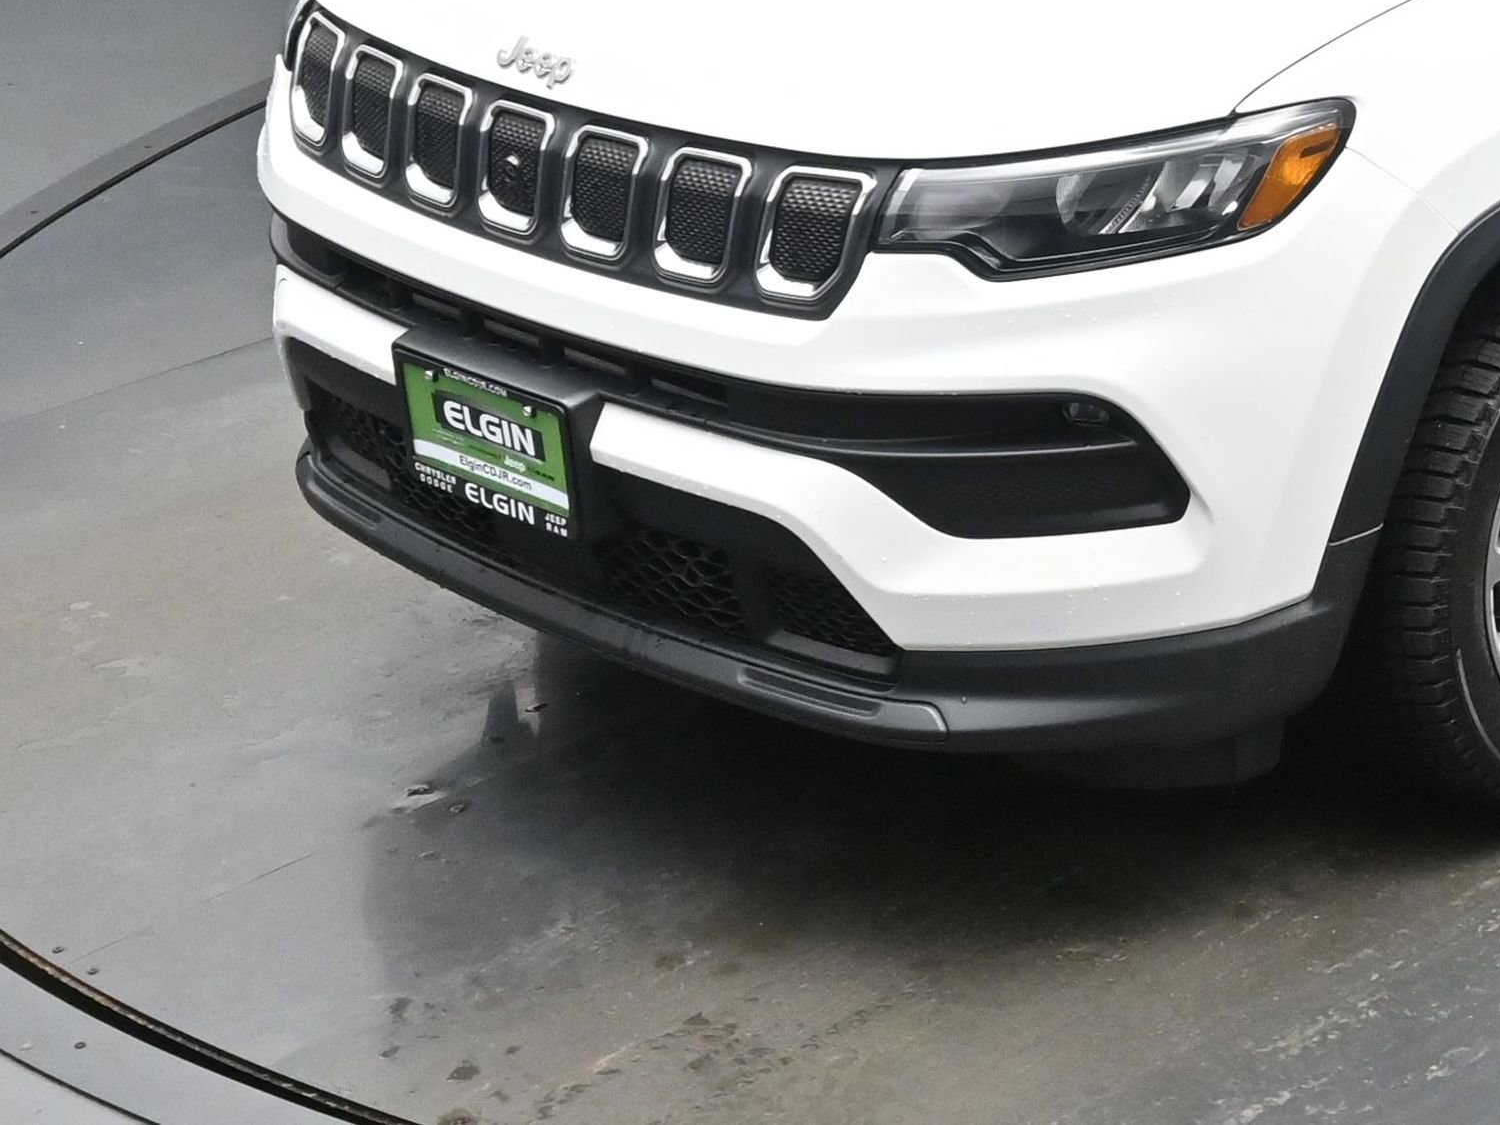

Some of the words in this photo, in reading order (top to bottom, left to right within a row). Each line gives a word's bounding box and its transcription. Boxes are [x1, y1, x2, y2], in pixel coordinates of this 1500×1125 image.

[496, 35, 576, 90] Jeep
[443, 400, 536, 457] ELGIN
[414, 461, 457, 485] CHRYSLER
[419, 473, 454, 494] DODGE
[459, 454, 533, 491] ElginCDJR.com
[464, 481, 535, 525] ELGIN
[544, 512, 567, 527] JEEP
[546, 523, 568, 538] RAM
